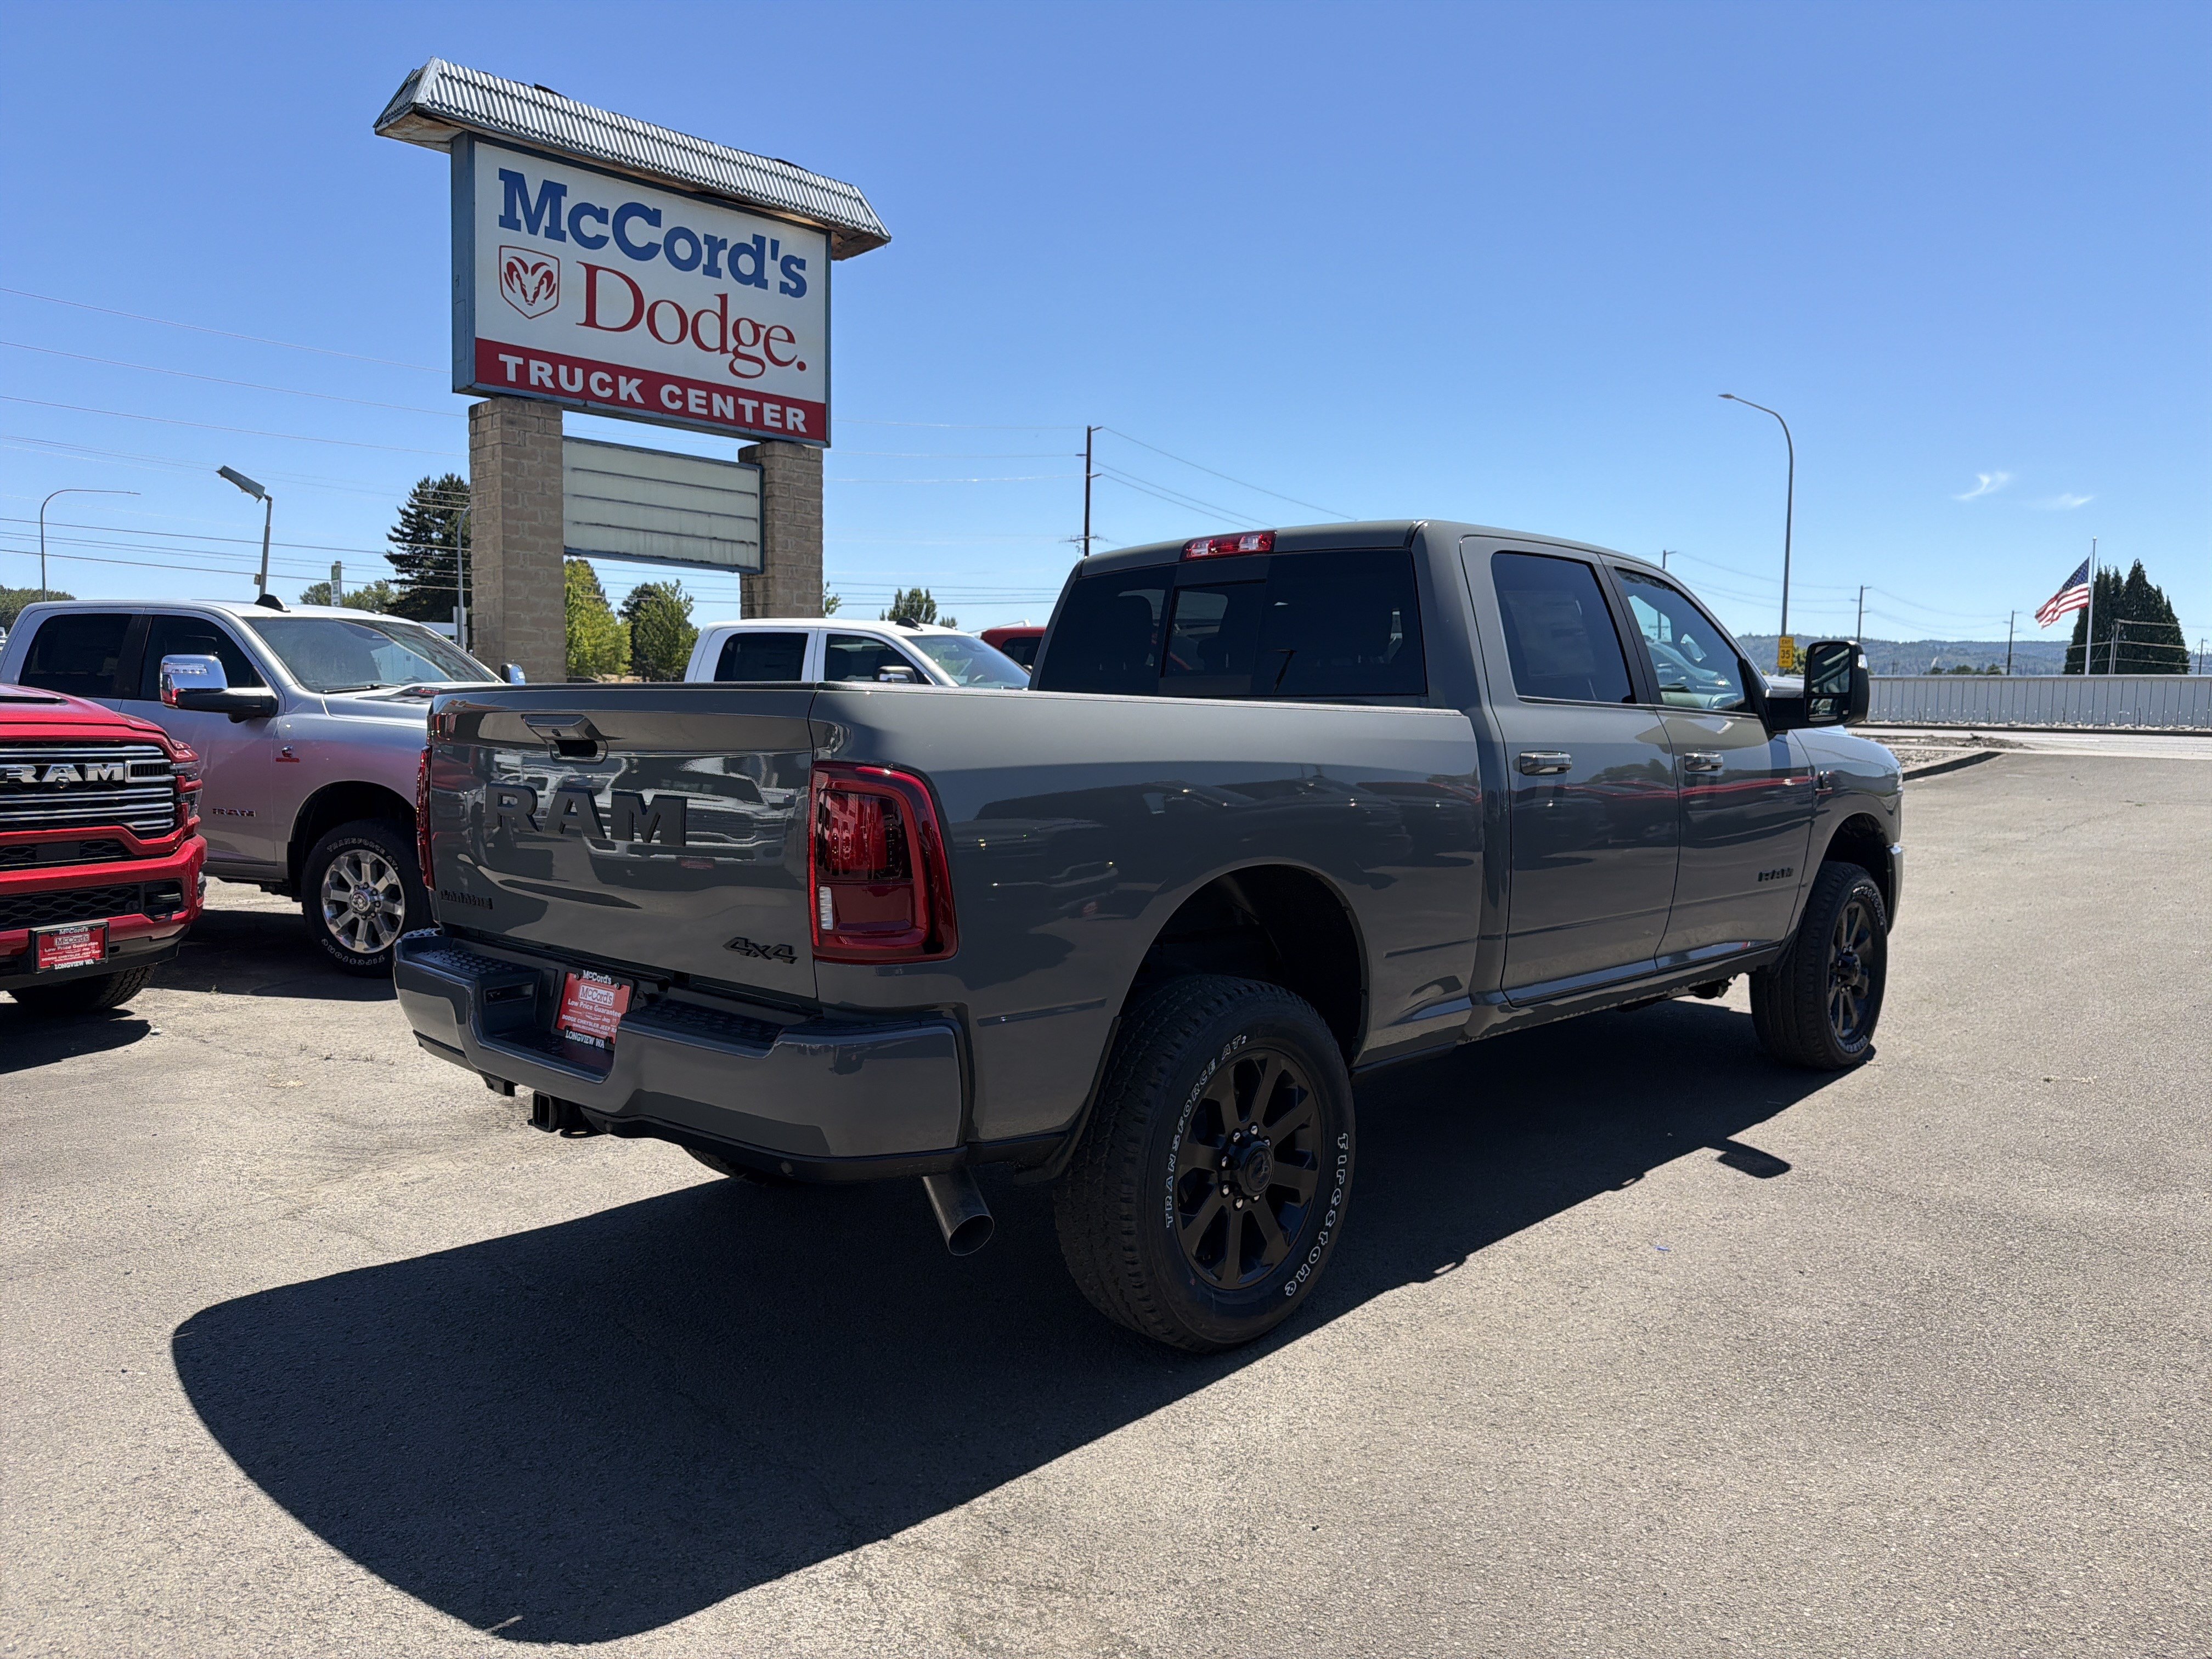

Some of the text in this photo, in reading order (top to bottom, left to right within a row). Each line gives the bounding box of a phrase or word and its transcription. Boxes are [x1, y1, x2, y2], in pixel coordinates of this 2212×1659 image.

[499, 167, 807, 298] McCord's
[499, 353, 807, 433] TRUCK CENTER
[1781, 649, 1790, 659] 35
[0, 764, 124, 783] RAM
[212, 807, 256, 817] RAM
[486, 783, 687, 847] RAM
[57, 935, 88, 944] McCord's
[54, 960, 84, 970] LONGVIEW
[583, 969, 612, 984] McCord's
[580, 986, 612, 1005] McCord's
[567, 998, 579, 1006] Low
[580, 1001, 592, 1011] Price
[594, 1005, 622, 1018] Guarantee
[577, 1018, 599, 1029] CHRYSLER
[565, 1030, 595, 1045] LONGVIEW
[596, 1038, 605, 1049] WA
[1166, 1058, 1216, 1228] TRANSFORCE
[1284, 1133, 1348, 1296] Firestone
